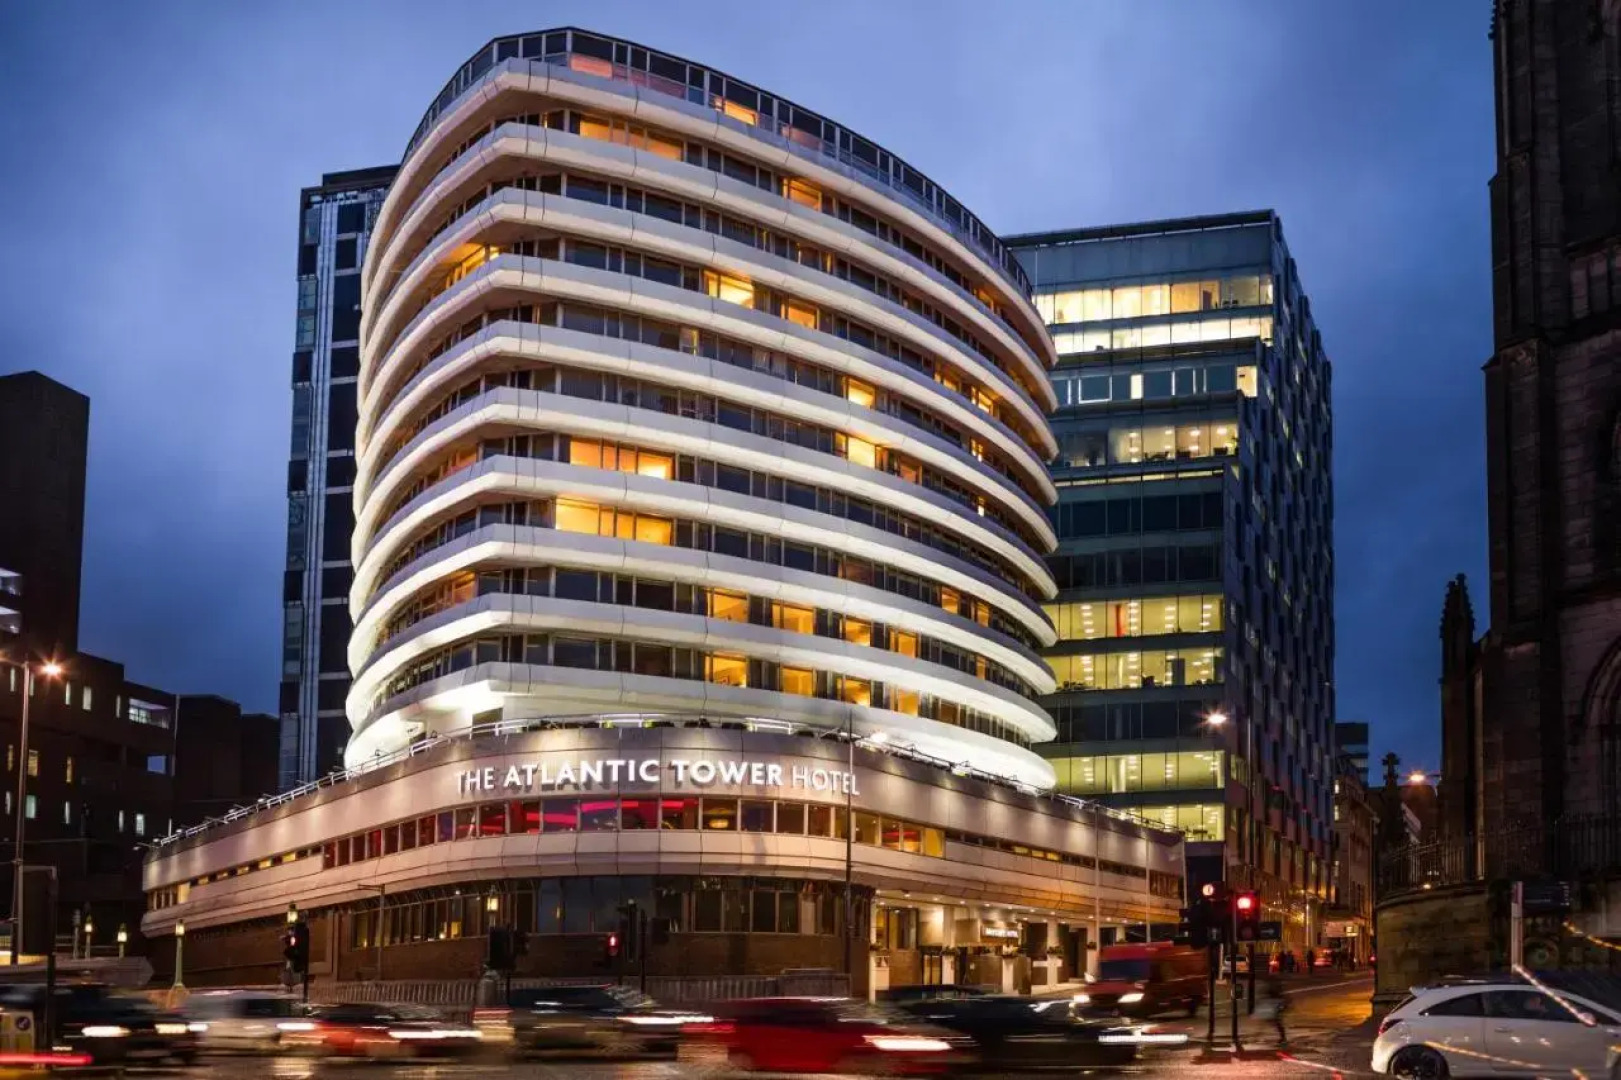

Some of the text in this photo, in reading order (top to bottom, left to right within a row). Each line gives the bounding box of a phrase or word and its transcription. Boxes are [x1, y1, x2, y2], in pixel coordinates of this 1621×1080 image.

[456, 759, 861, 796] THE ATLANTIC TOWER HOTEL
